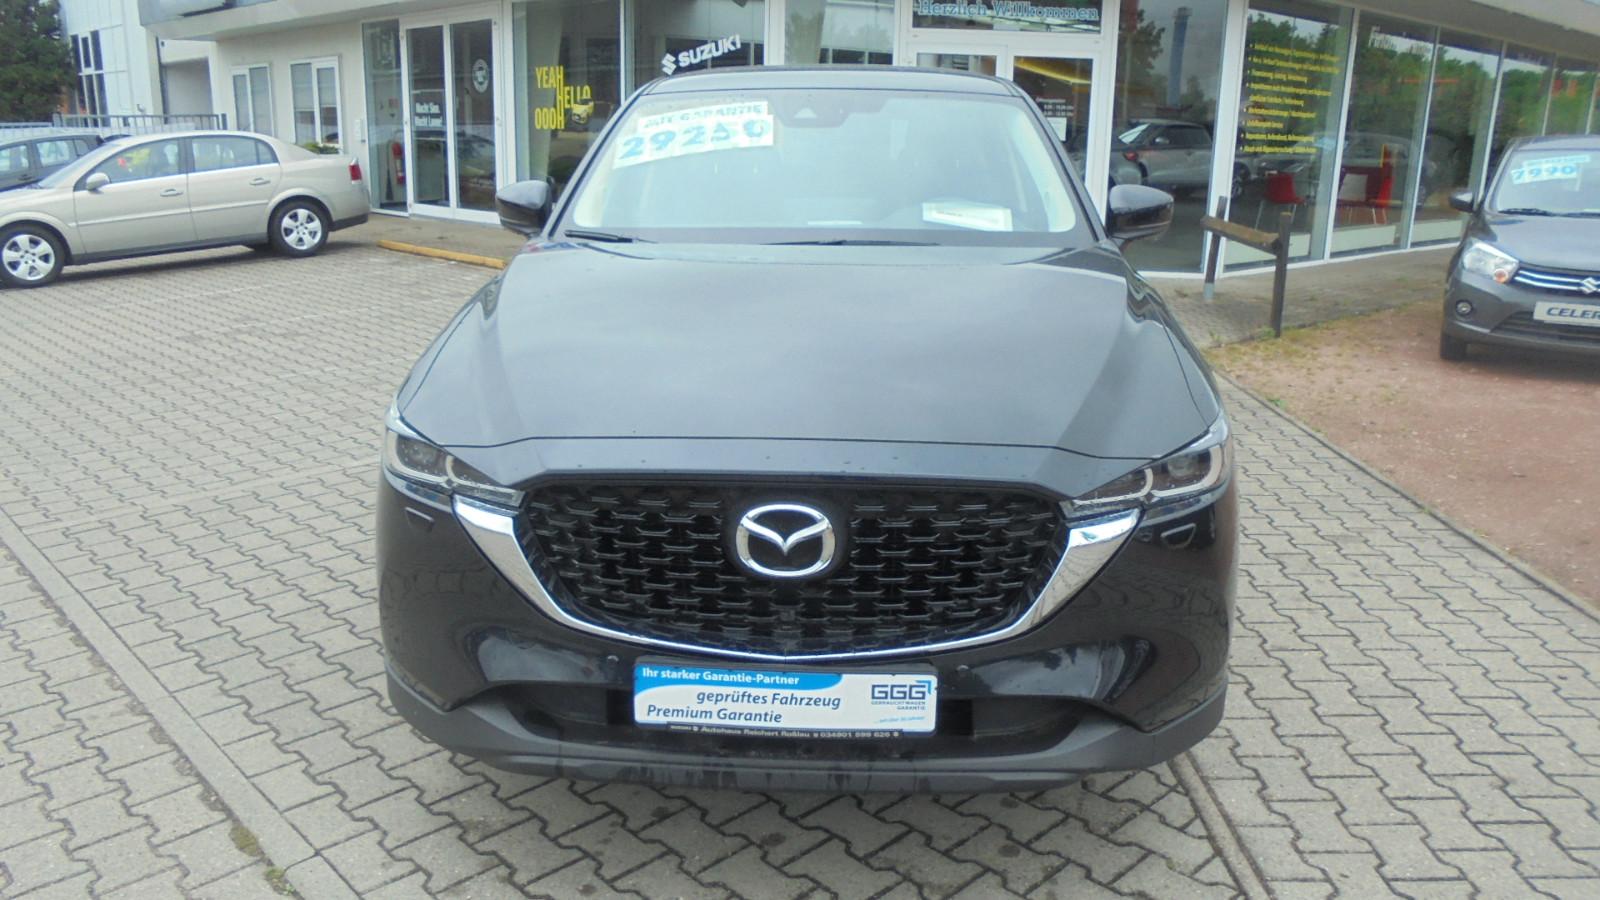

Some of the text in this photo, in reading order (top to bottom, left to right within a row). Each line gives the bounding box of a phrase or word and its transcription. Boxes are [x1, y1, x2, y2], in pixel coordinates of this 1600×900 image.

[917, 0, 1100, 20] Herzlich Willkommen
[678, 34, 742, 68] SUZUKI
[535, 65, 564, 88] YEAH
[556, 83, 592, 111] HELLO
[535, 106, 565, 129] OOOH
[642, 667, 800, 685] Ihr starker Garantie-Partner
[696, 690, 841, 710] geprüftes Fahrzeug
[871, 684, 926, 700] GGG
[647, 704, 783, 723] Premium Garantie
[700, 726, 742, 735] Autohaus
